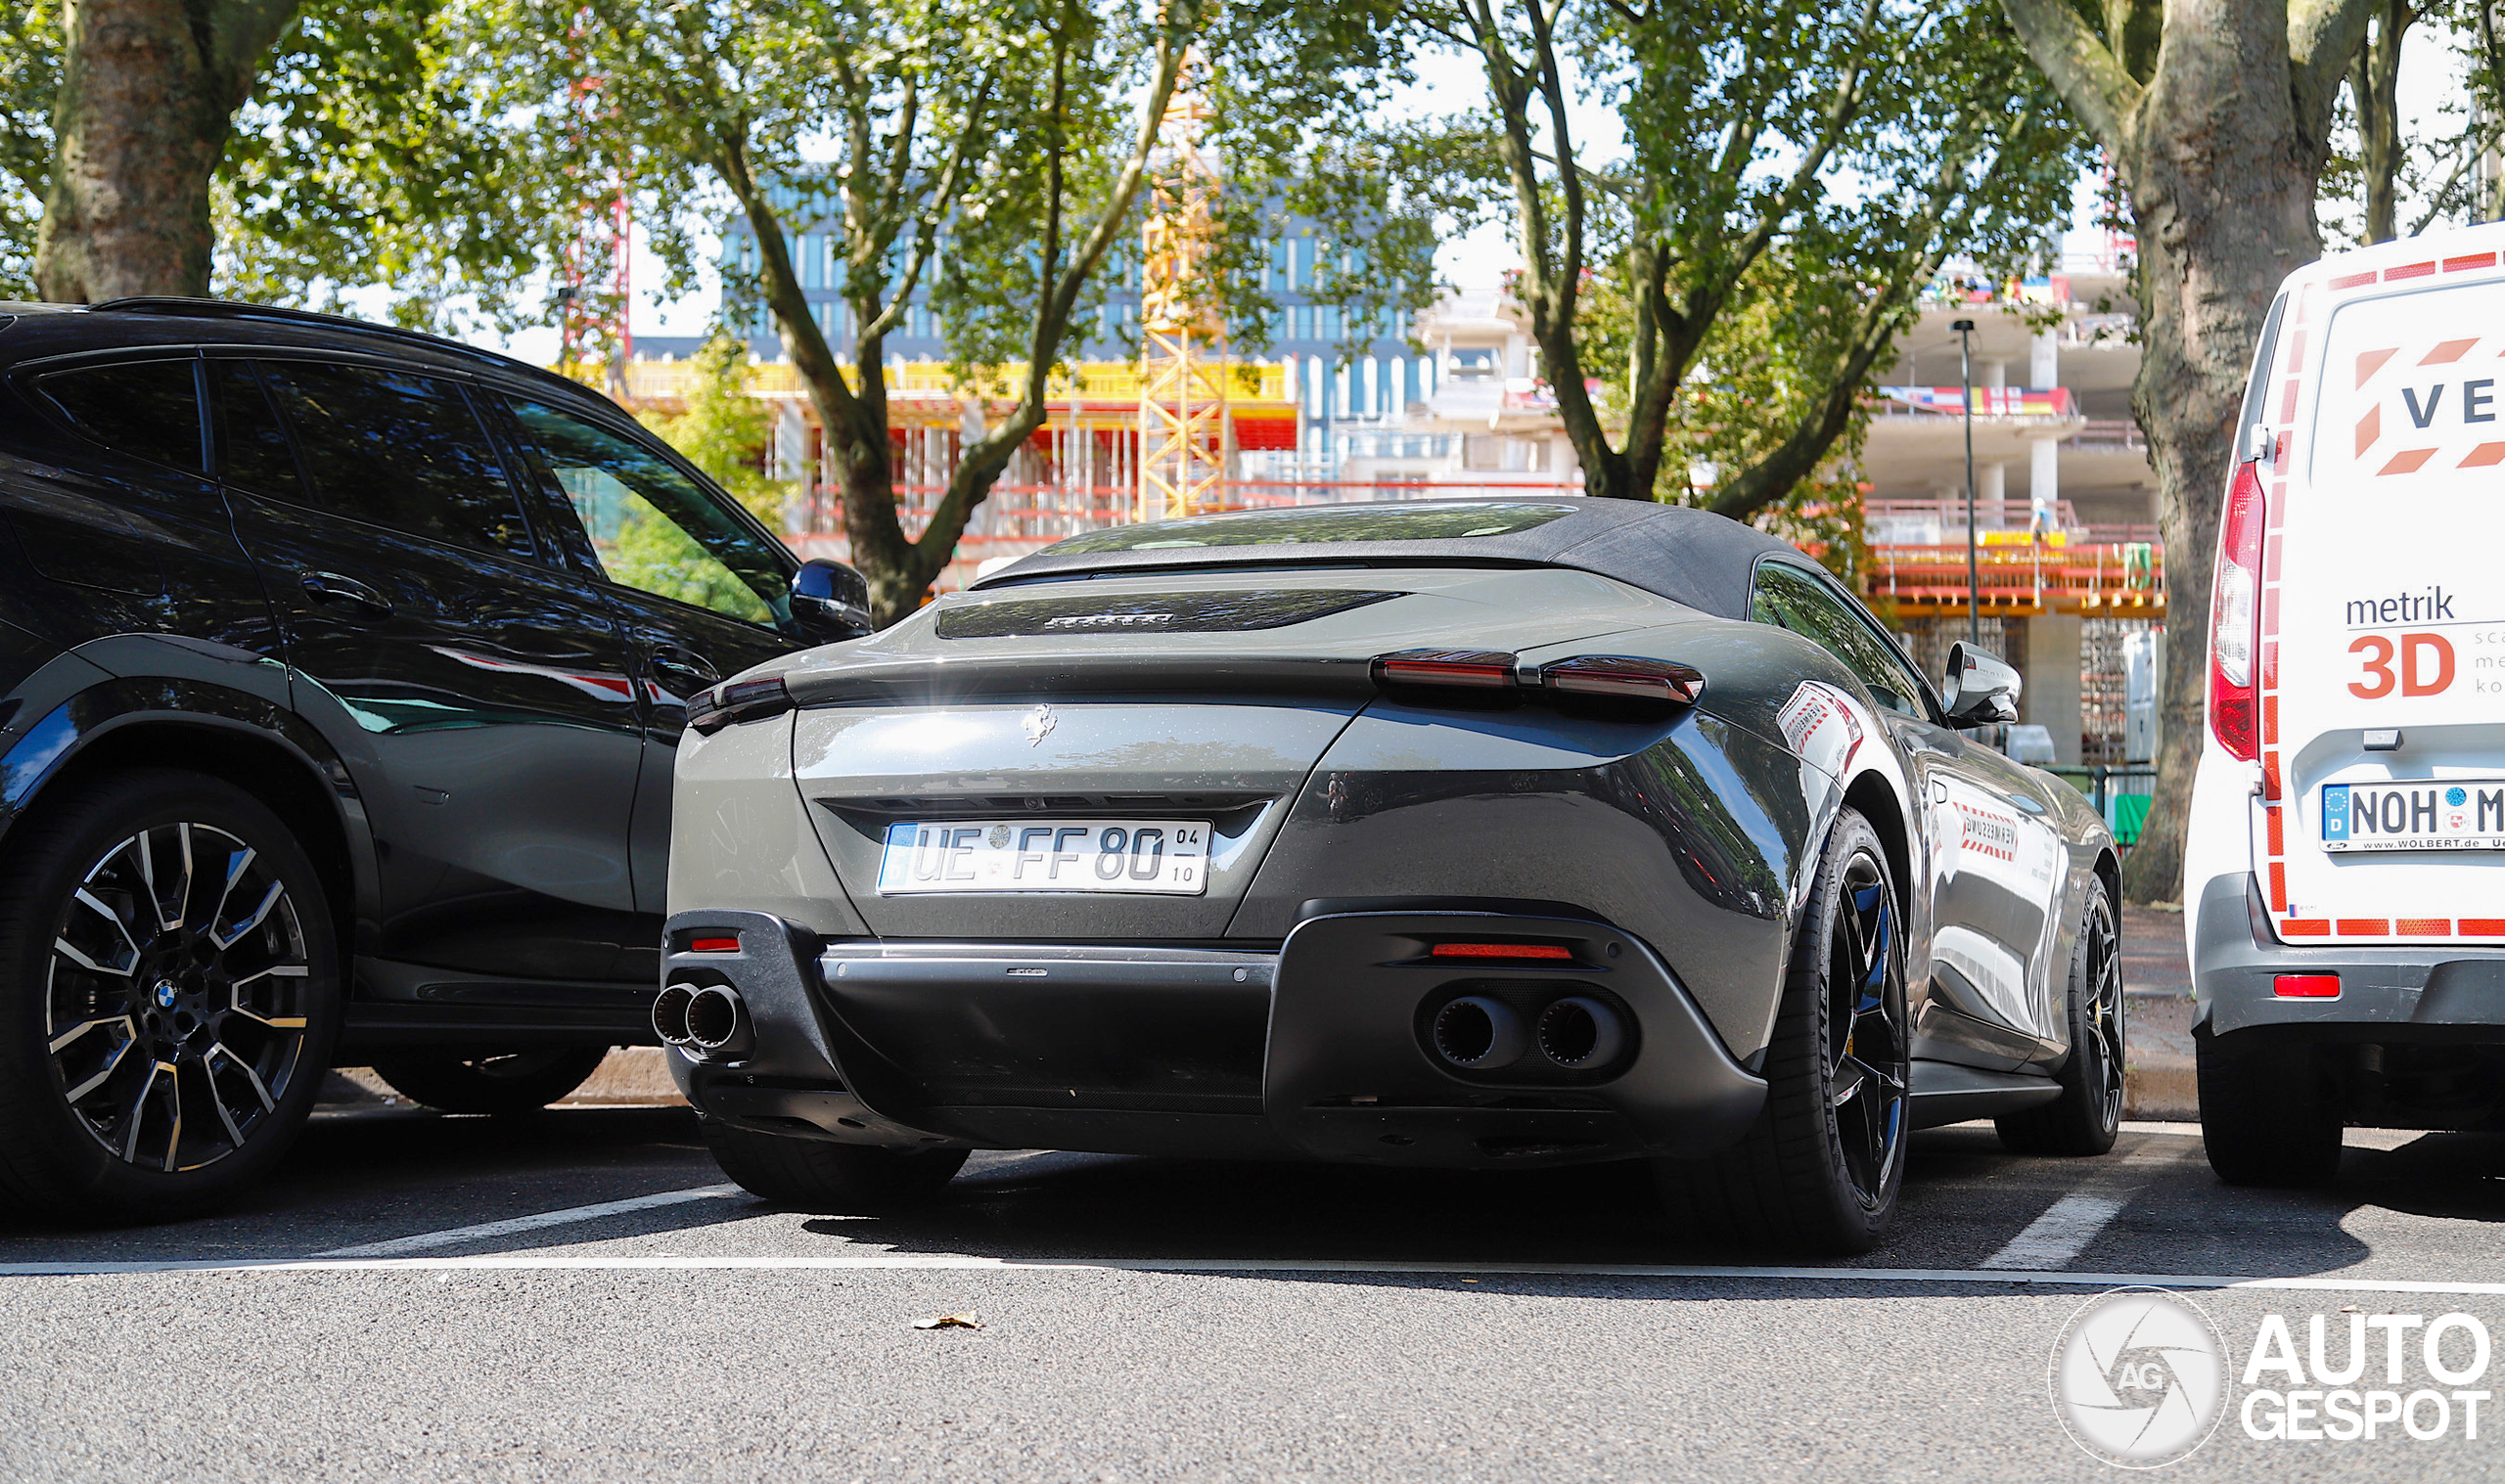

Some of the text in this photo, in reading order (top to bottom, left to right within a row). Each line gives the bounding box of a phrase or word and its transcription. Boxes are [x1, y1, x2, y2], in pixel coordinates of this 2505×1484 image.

[2401, 379, 2496, 428] VE
[2346, 585, 2455, 624] metrik
[2346, 632, 2456, 699] 3D
[2476, 678, 2502, 694] ko
[2330, 818, 2343, 832] D
[2352, 789, 2437, 834] NOH
[2477, 788, 2505, 832] M
[914, 829, 981, 880] UE
[1013, 828, 1088, 879] FF
[1094, 827, 1164, 880] 80
[1176, 829, 1199, 845] 04
[2363, 839, 2481, 849] www.WOLBERT.de
[1173, 867, 1193, 881] 10
[1820, 981, 1836, 1135] MICHELIN
